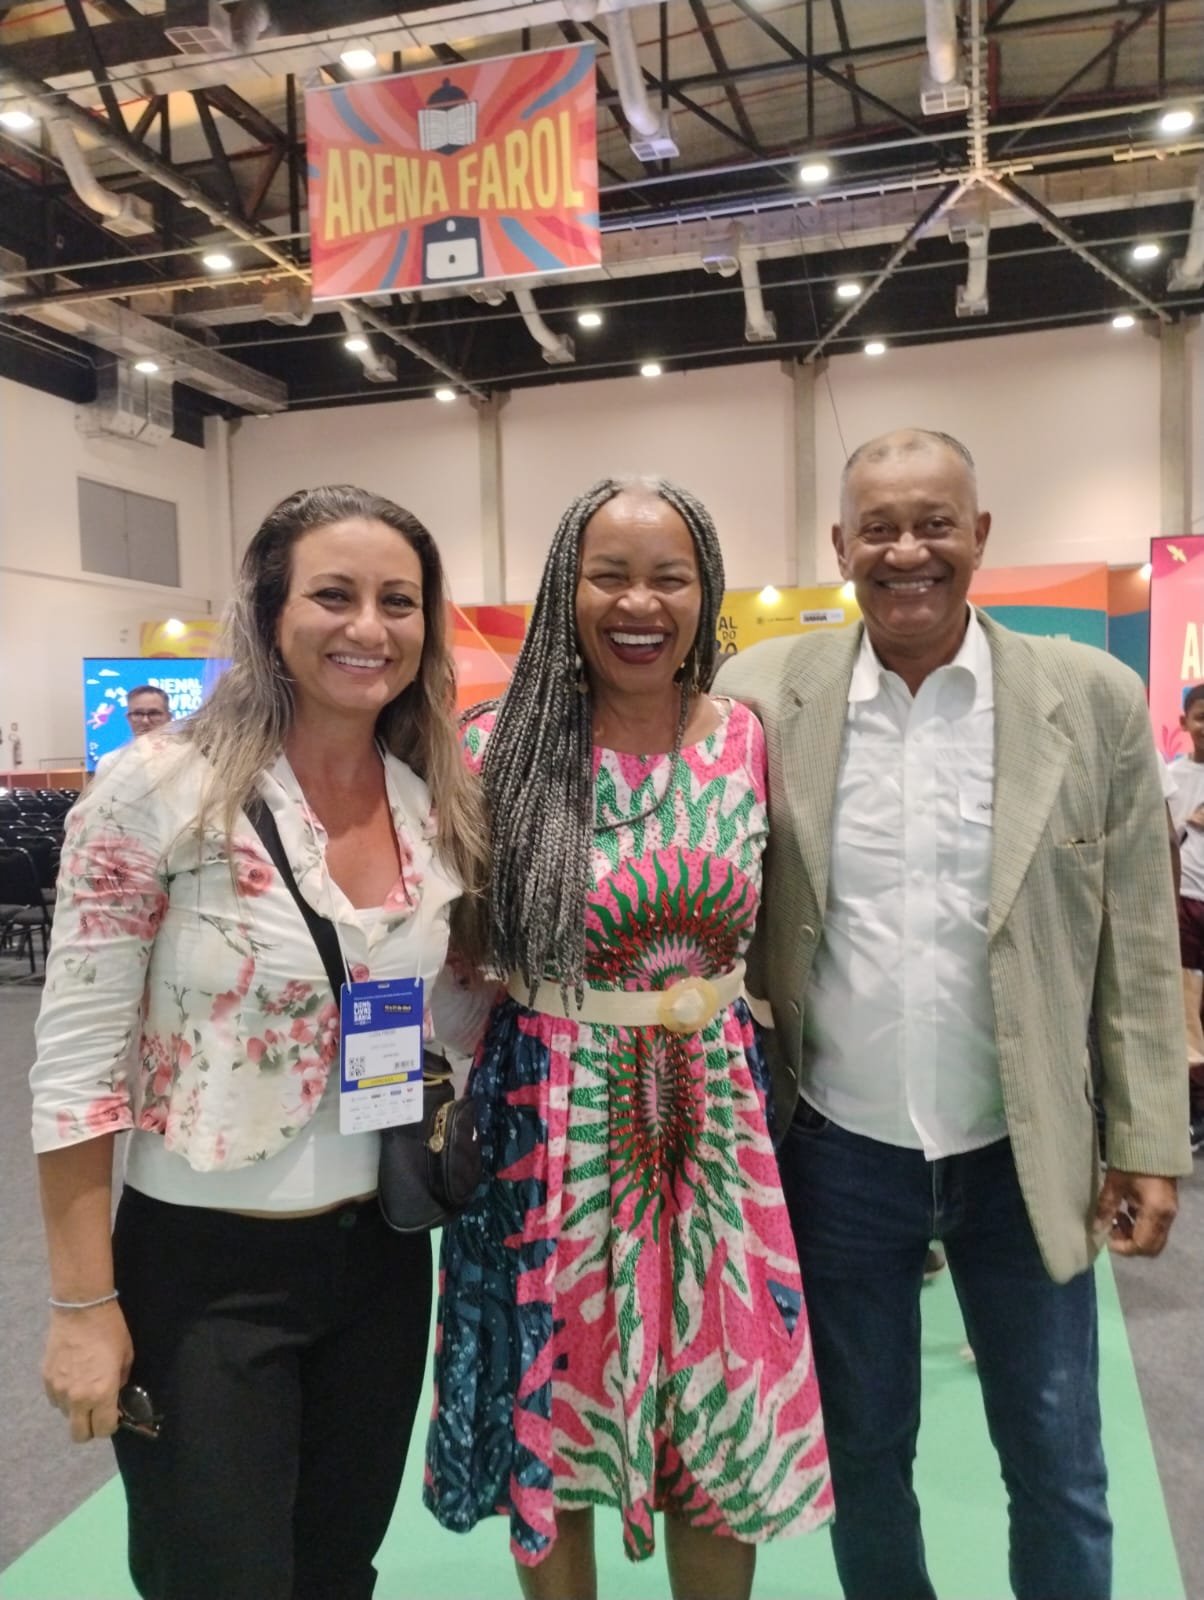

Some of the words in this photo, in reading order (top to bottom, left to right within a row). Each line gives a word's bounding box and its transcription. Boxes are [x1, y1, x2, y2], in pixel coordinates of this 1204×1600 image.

[325, 148, 449, 241] ARENA
[458, 111, 584, 211] FAROL
[718, 616, 738, 631] AL
[722, 630, 737, 641] DO
[1180, 622, 1204, 680] A
